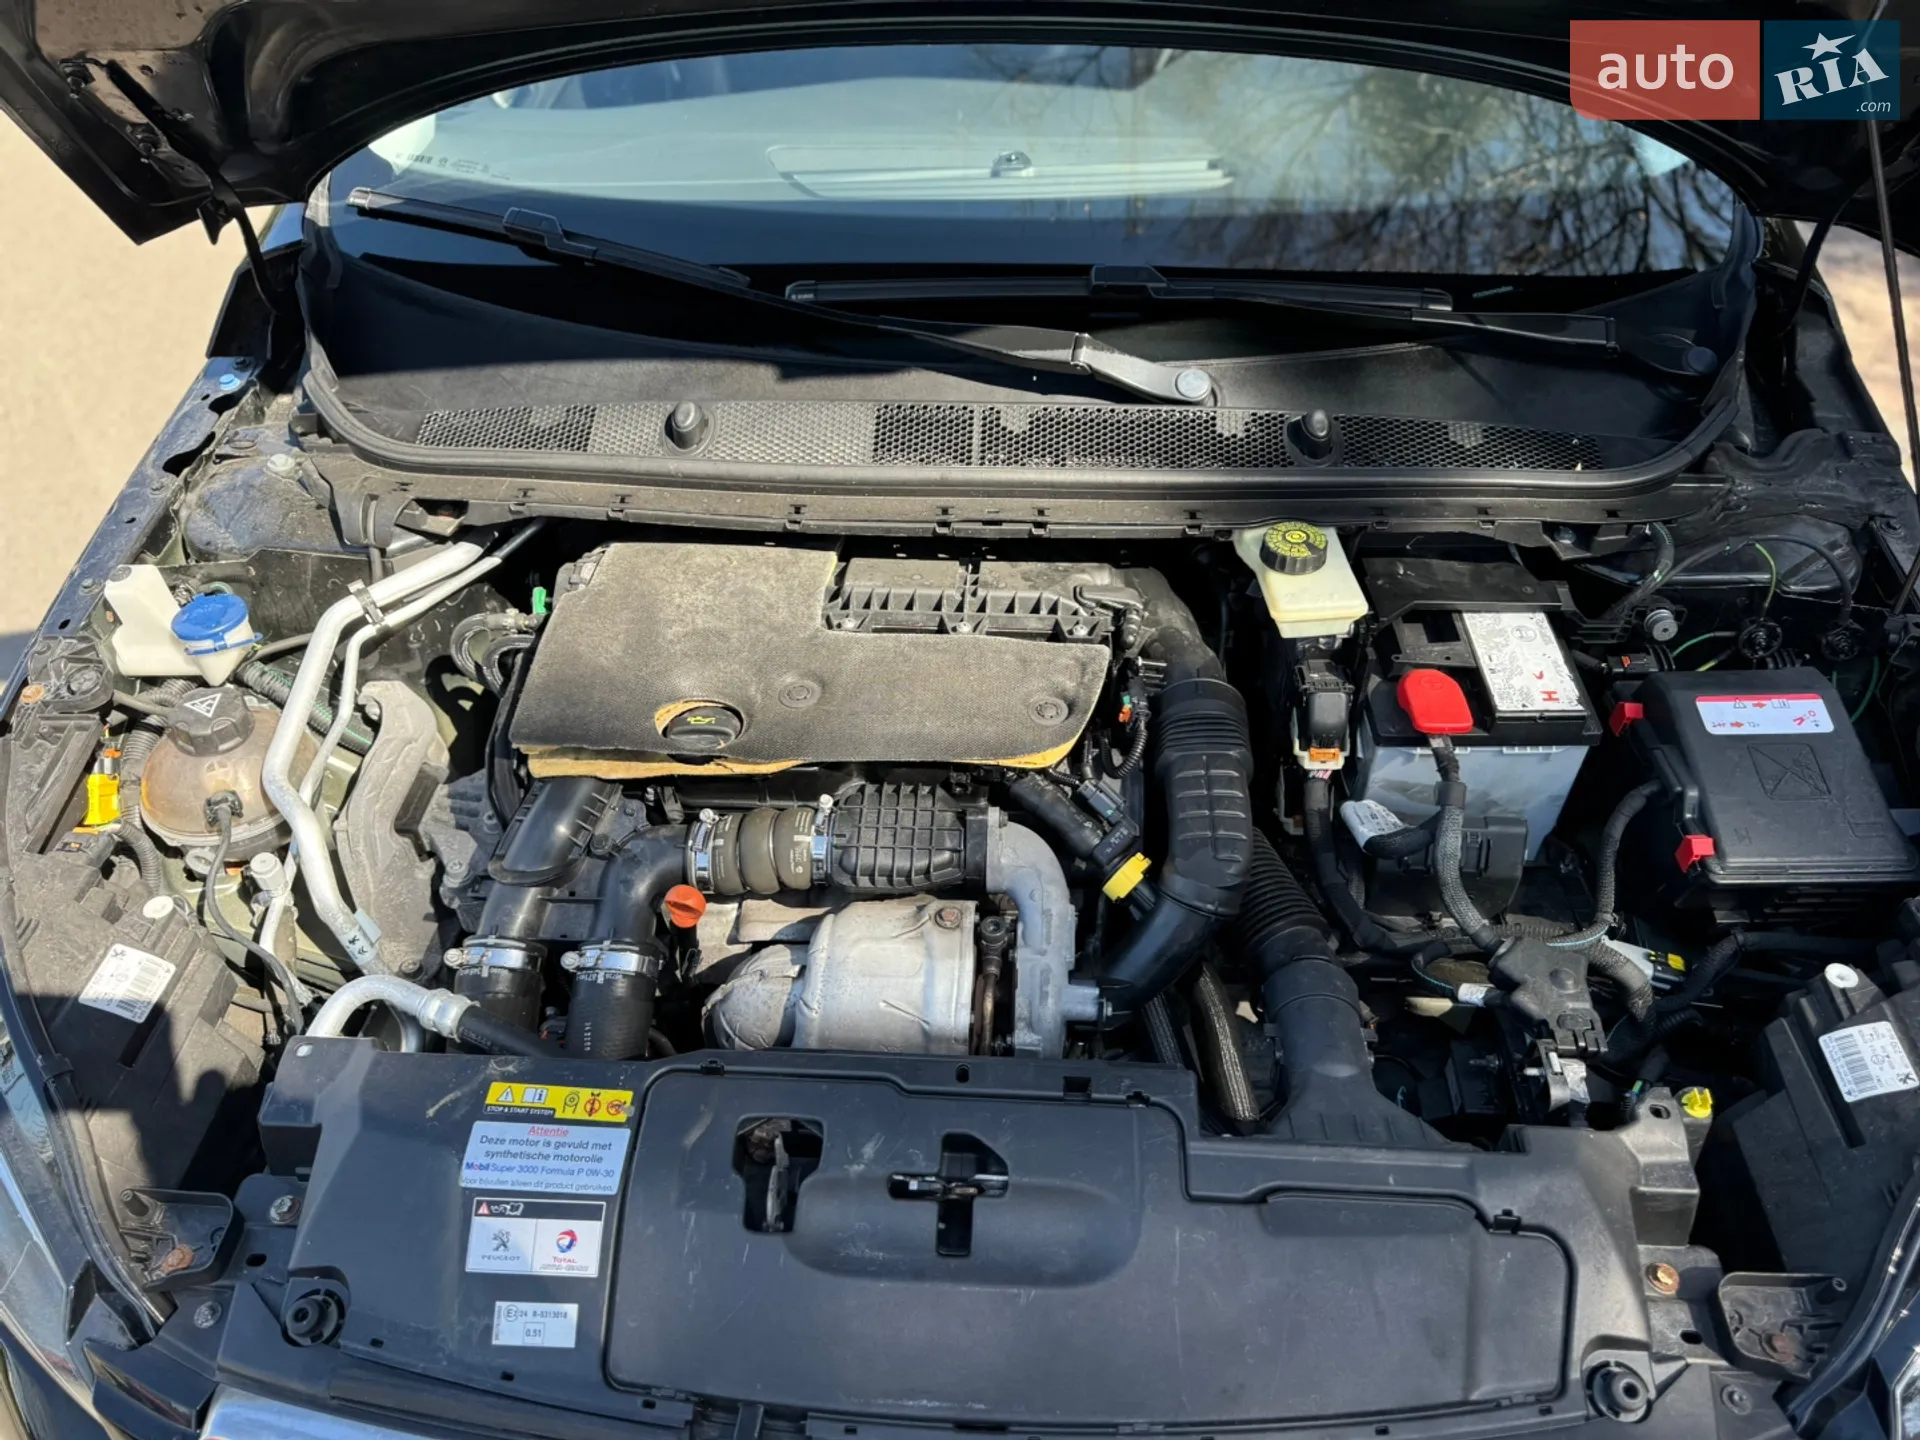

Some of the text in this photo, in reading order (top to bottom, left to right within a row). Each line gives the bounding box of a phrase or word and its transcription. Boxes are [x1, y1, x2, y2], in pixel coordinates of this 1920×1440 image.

[528, 1125, 569, 1137] Attentie
[480, 1135, 612, 1151] Deze motor is gevuld met
[484, 1149, 604, 1164] synthetische motorolie
[465, 1161, 490, 1171] Mobil
[491, 1163, 516, 1174] Super
[517, 1164, 539, 1174] 3000
[540, 1166, 575, 1176] Formula
[577, 1167, 585, 1176] P
[543, 1180, 573, 1190] product
[552, 1256, 578, 1264] TOTAL
[525, 1328, 542, 1338] 0.51
